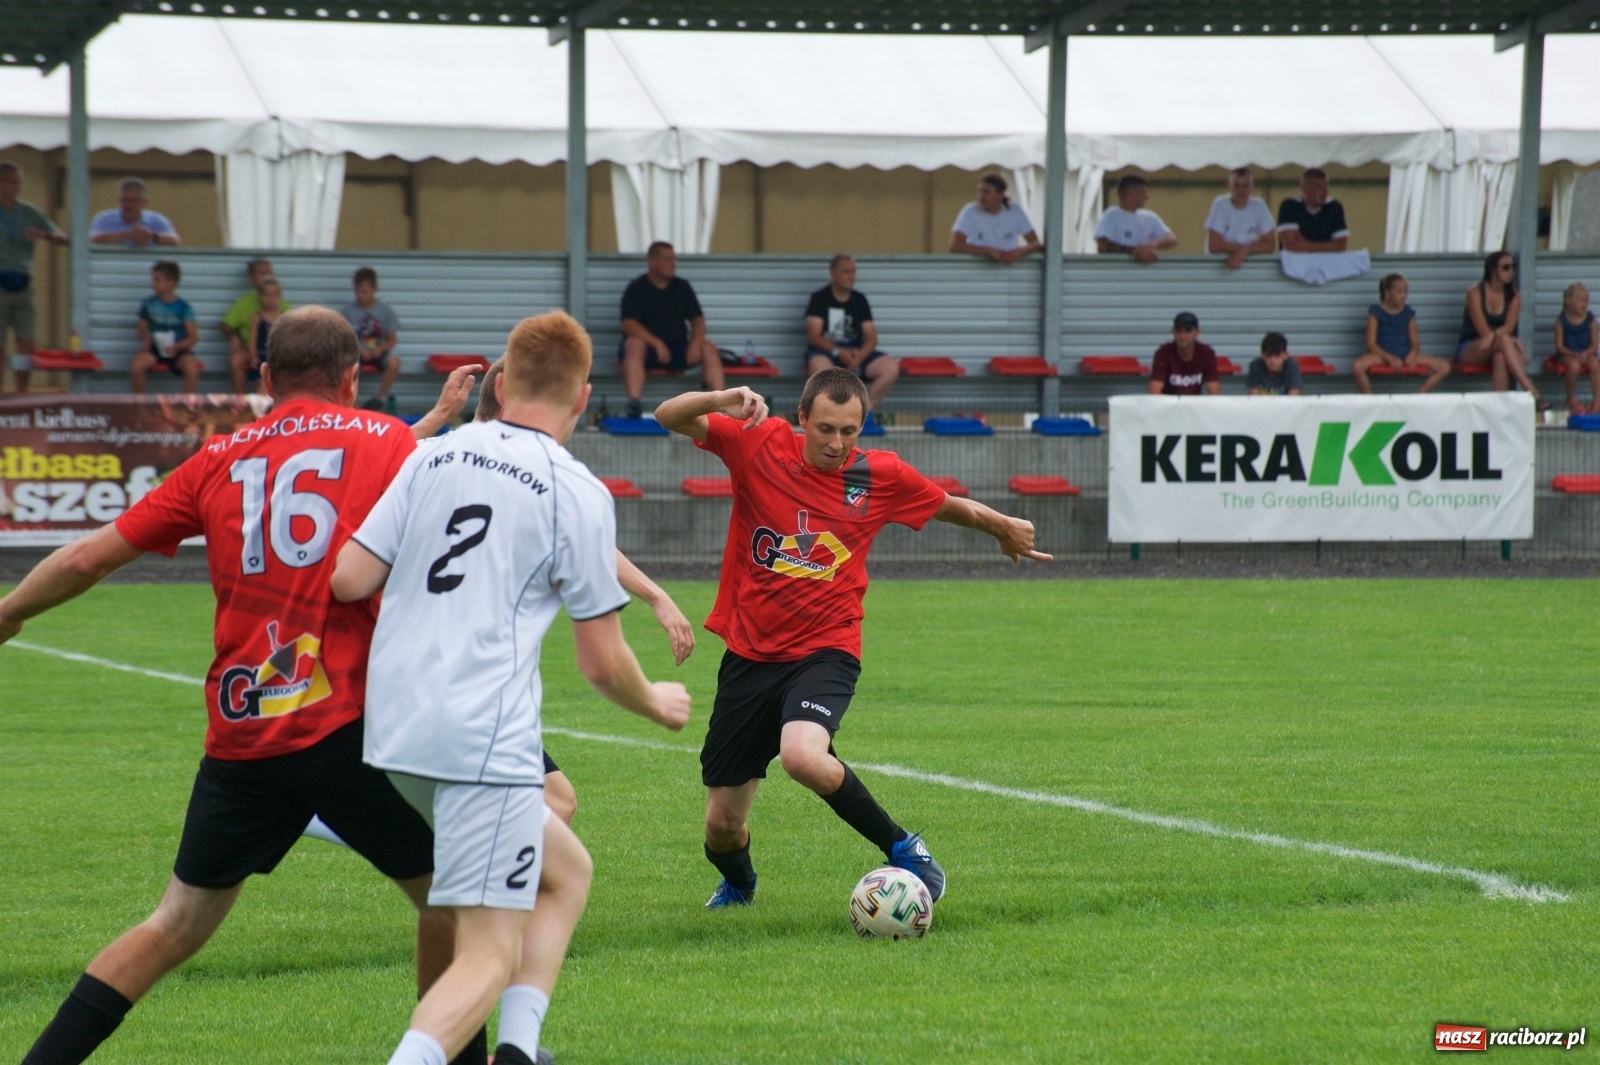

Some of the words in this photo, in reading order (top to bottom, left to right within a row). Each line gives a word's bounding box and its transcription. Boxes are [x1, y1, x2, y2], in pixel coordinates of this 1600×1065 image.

[462, 452, 548, 496] TWORKÓW
[1141, 421, 1502, 486] KERAKOLL
[229, 448, 345, 577] 16
[1221, 491, 1255, 508] The
[1261, 490, 1400, 513] GreenBuilding
[1407, 489, 1502, 512] Company
[427, 504, 492, 594] 2
[811, 702, 832, 717] VIGO
[506, 845, 535, 889] 2
